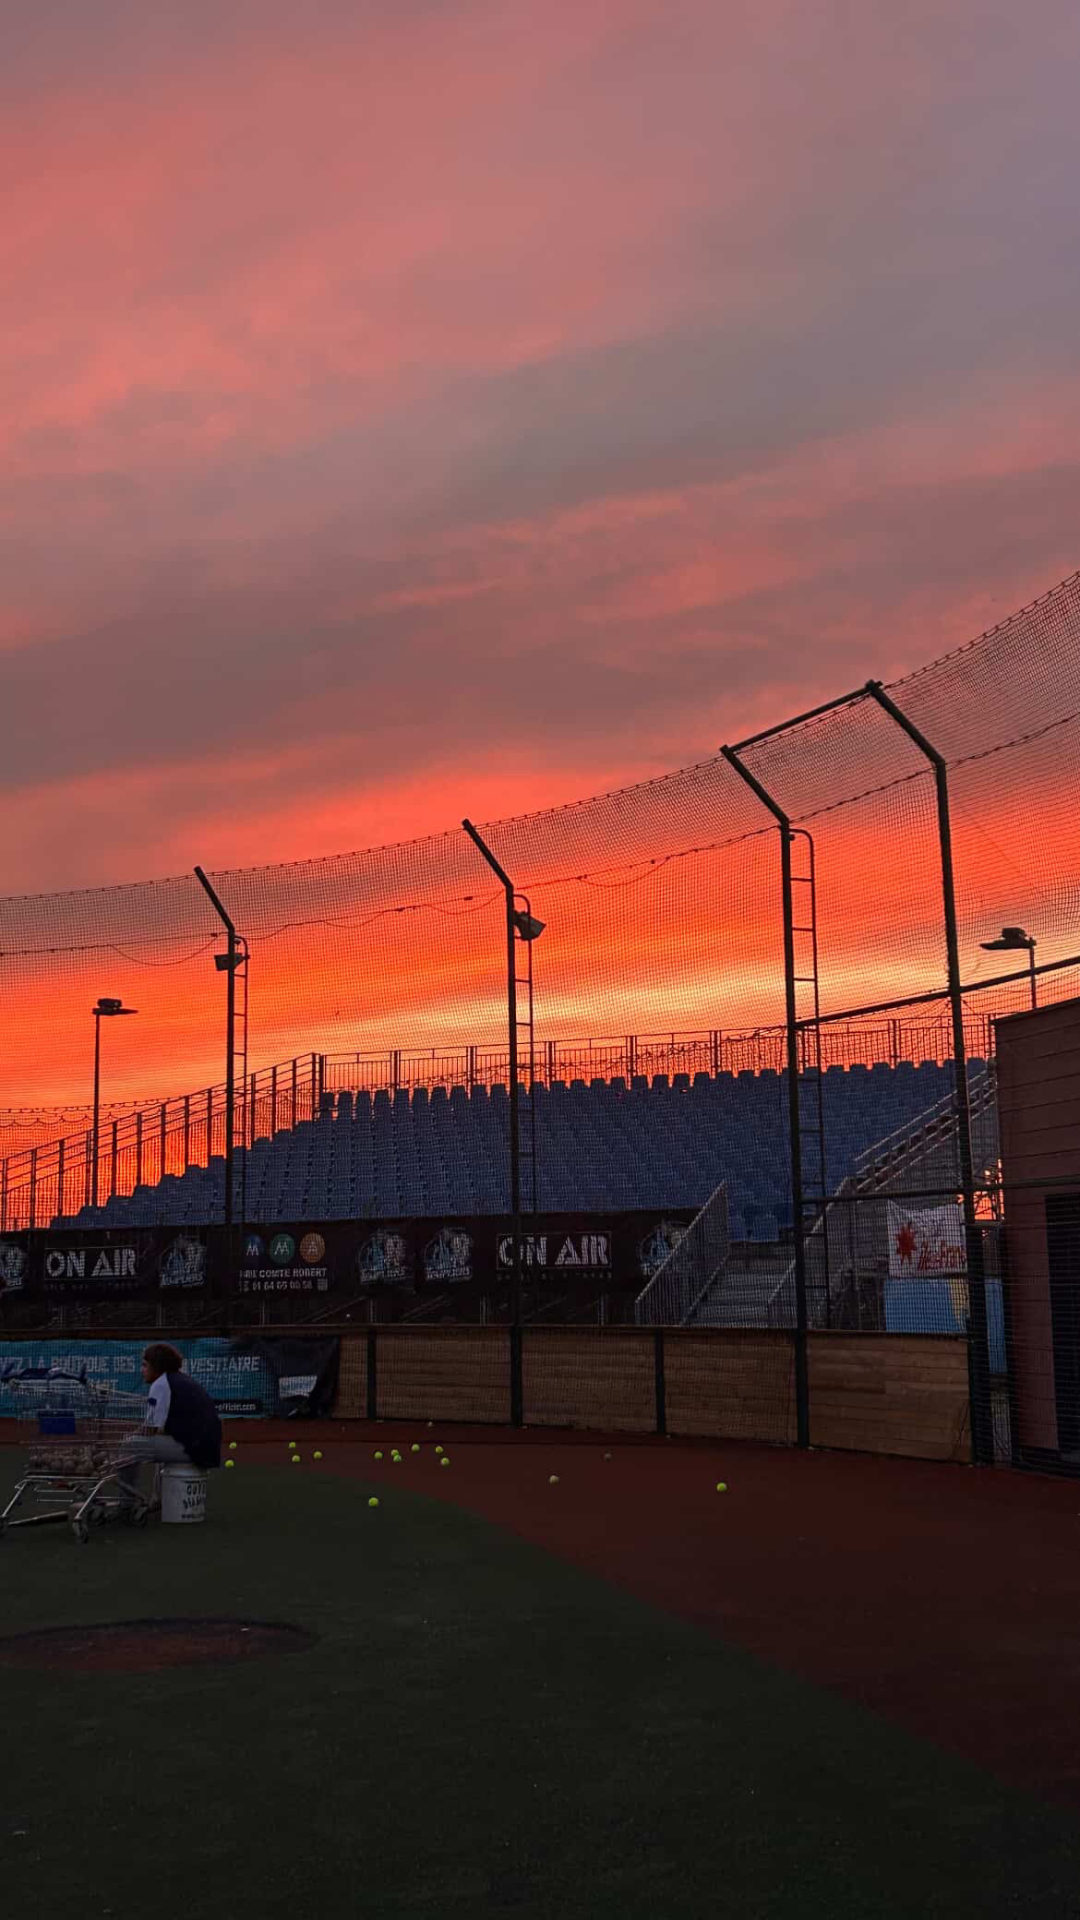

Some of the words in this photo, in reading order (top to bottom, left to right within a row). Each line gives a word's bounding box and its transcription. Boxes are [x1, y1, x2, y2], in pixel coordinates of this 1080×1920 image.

[555, 1235, 609, 1265] AIR
[47, 1250, 86, 1277] ON
[91, 1248, 138, 1276] AIR
[292, 1267, 328, 1278] ROBERT
[190, 1356, 261, 1373] VESTIAIRE
